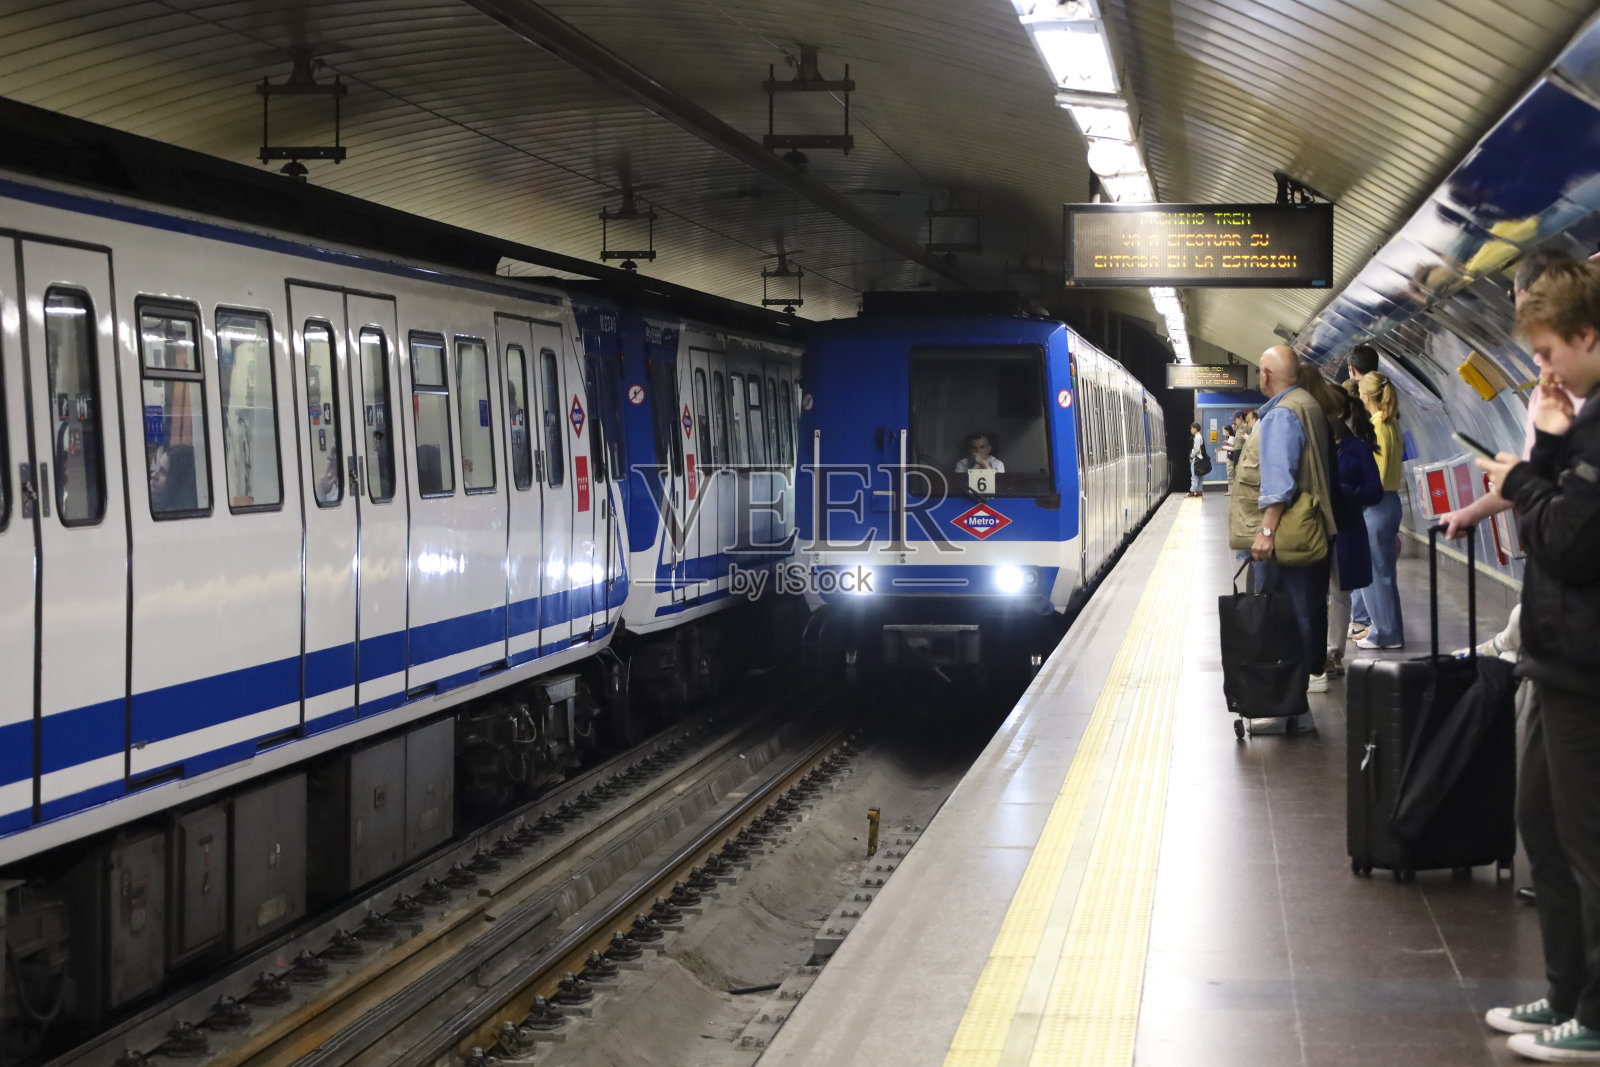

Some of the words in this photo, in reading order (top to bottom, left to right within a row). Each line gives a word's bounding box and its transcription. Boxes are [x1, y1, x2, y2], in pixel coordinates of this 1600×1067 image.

[1214, 212, 1251, 225] TREN
[1122, 233, 1140, 247] VA
[1149, 233, 1159, 247] A
[1167, 233, 1242, 247] EFECTUAR
[1250, 233, 1270, 247] SU
[1094, 254, 1159, 268] ENTRADA
[1167, 254, 1187, 268] EN
[1195, 254, 1214, 268] LA
[1222, 254, 1298, 268] ESTACION
[977, 477, 987, 492] 6
[968, 517, 995, 526] Metro
